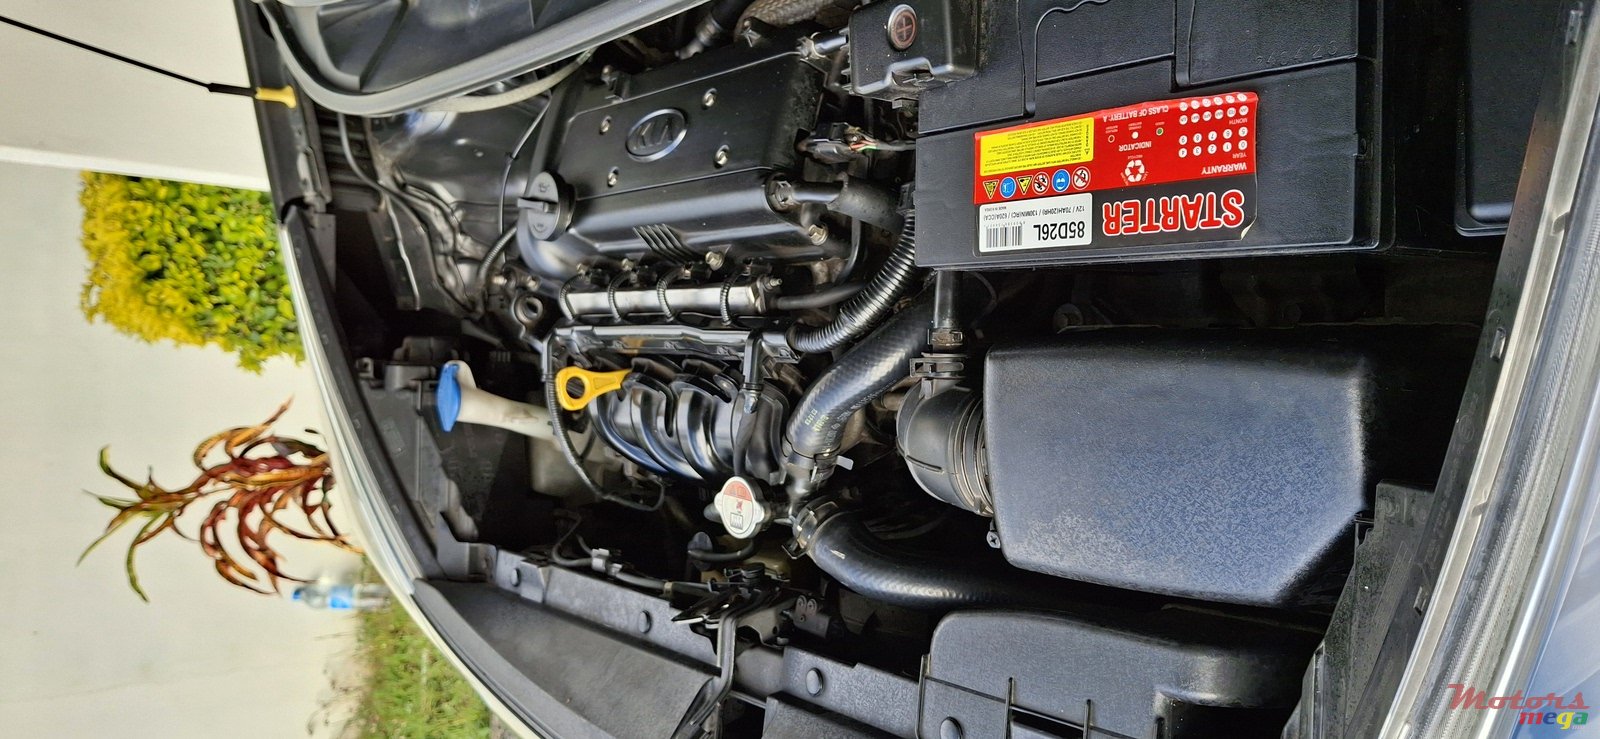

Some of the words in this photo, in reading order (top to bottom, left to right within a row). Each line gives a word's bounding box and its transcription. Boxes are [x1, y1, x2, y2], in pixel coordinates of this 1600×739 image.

[1148, 105, 1168, 115] CLASS
[1102, 115, 1108, 123] A
[1118, 141, 1151, 151] INDICATOR
[1201, 162, 1246, 174] WARRANTY
[1102, 190, 1244, 235] STARTER
[1033, 221, 1085, 240] 85D26L
